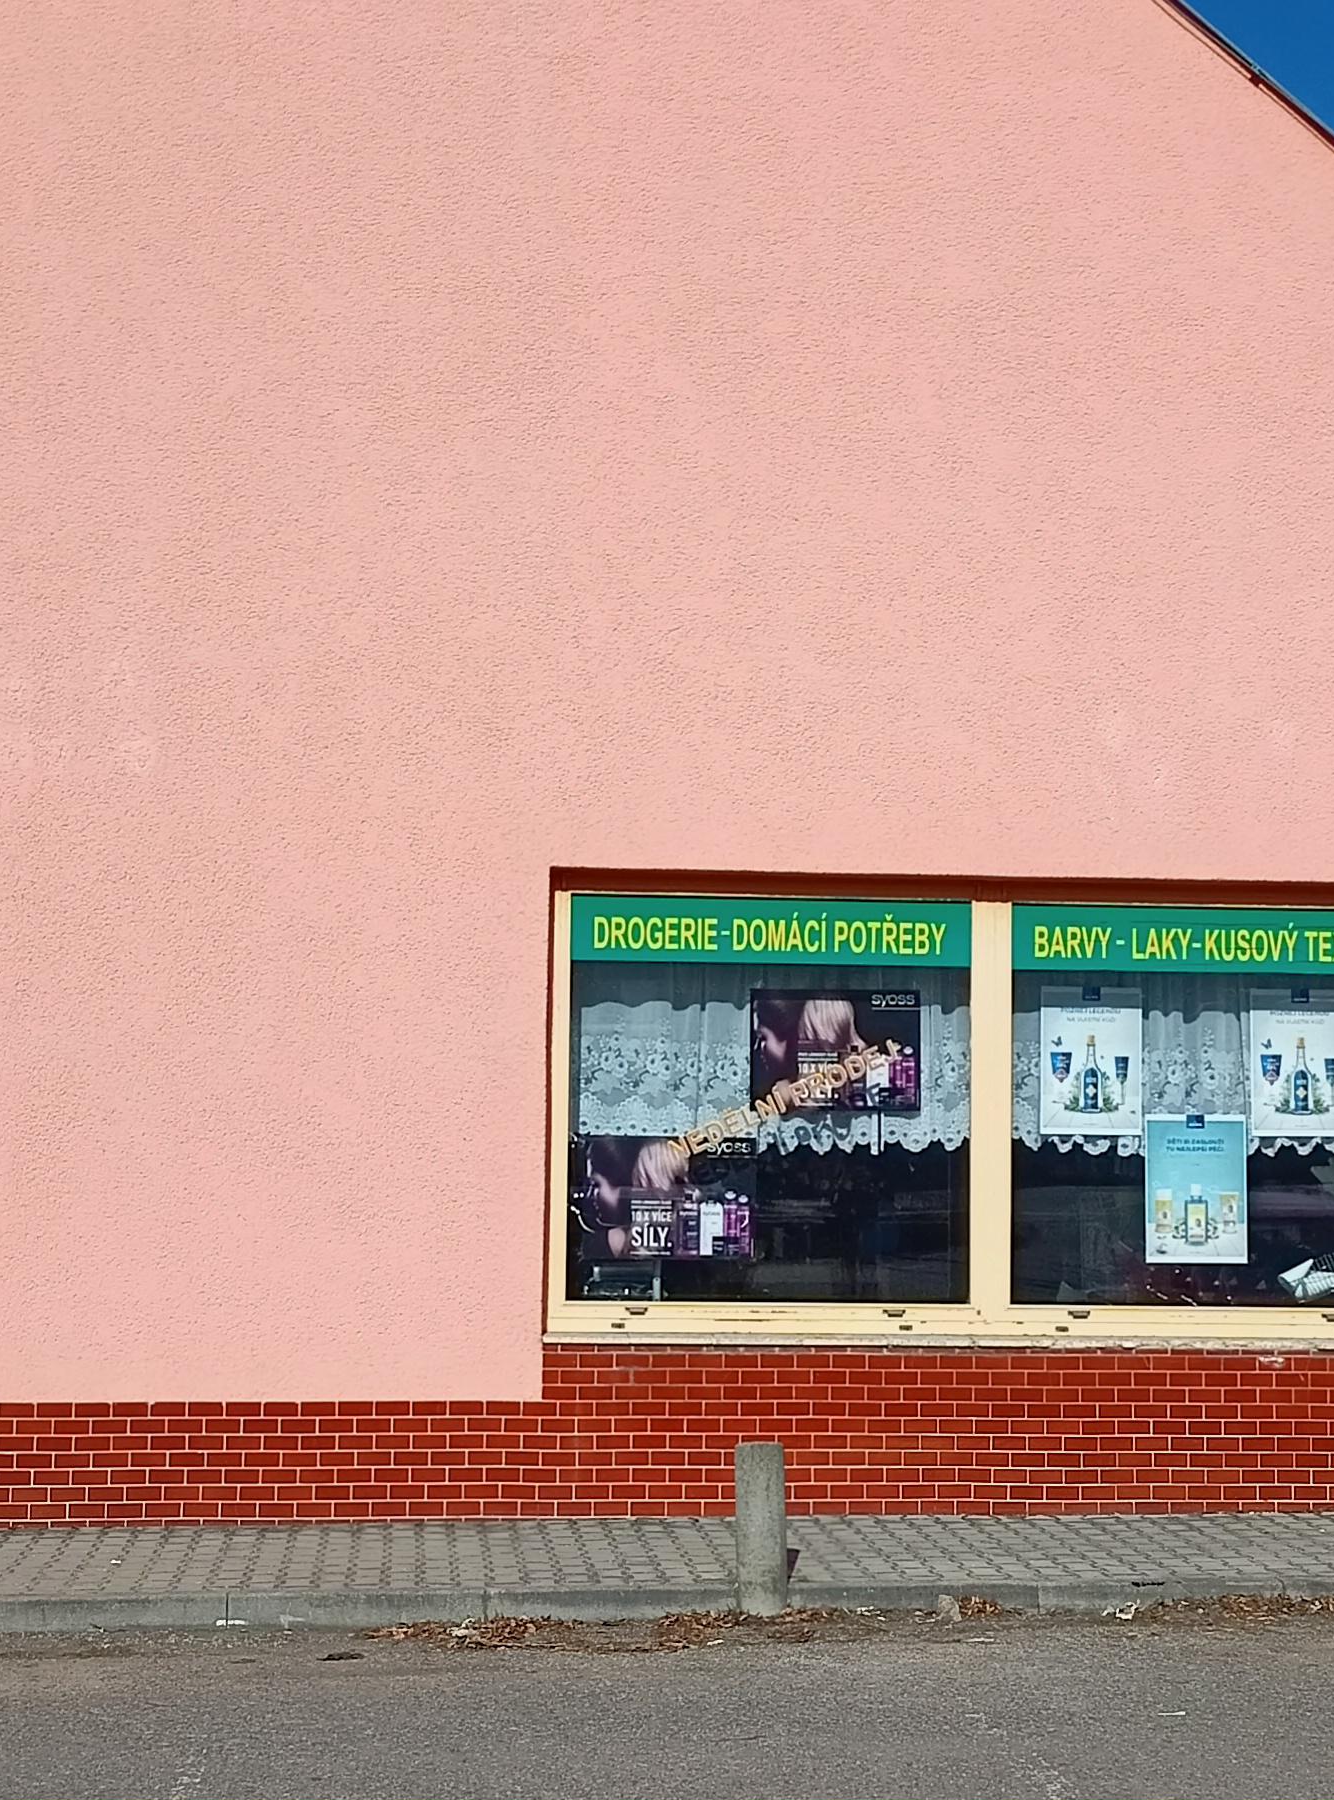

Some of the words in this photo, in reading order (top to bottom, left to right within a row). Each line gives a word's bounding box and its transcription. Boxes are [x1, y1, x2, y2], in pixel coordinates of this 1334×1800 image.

[834, 914, 946, 955] POTŘEBY
[1034, 926, 1112, 959] BARVY
[631, 1222, 672, 1247] SÍLY.
